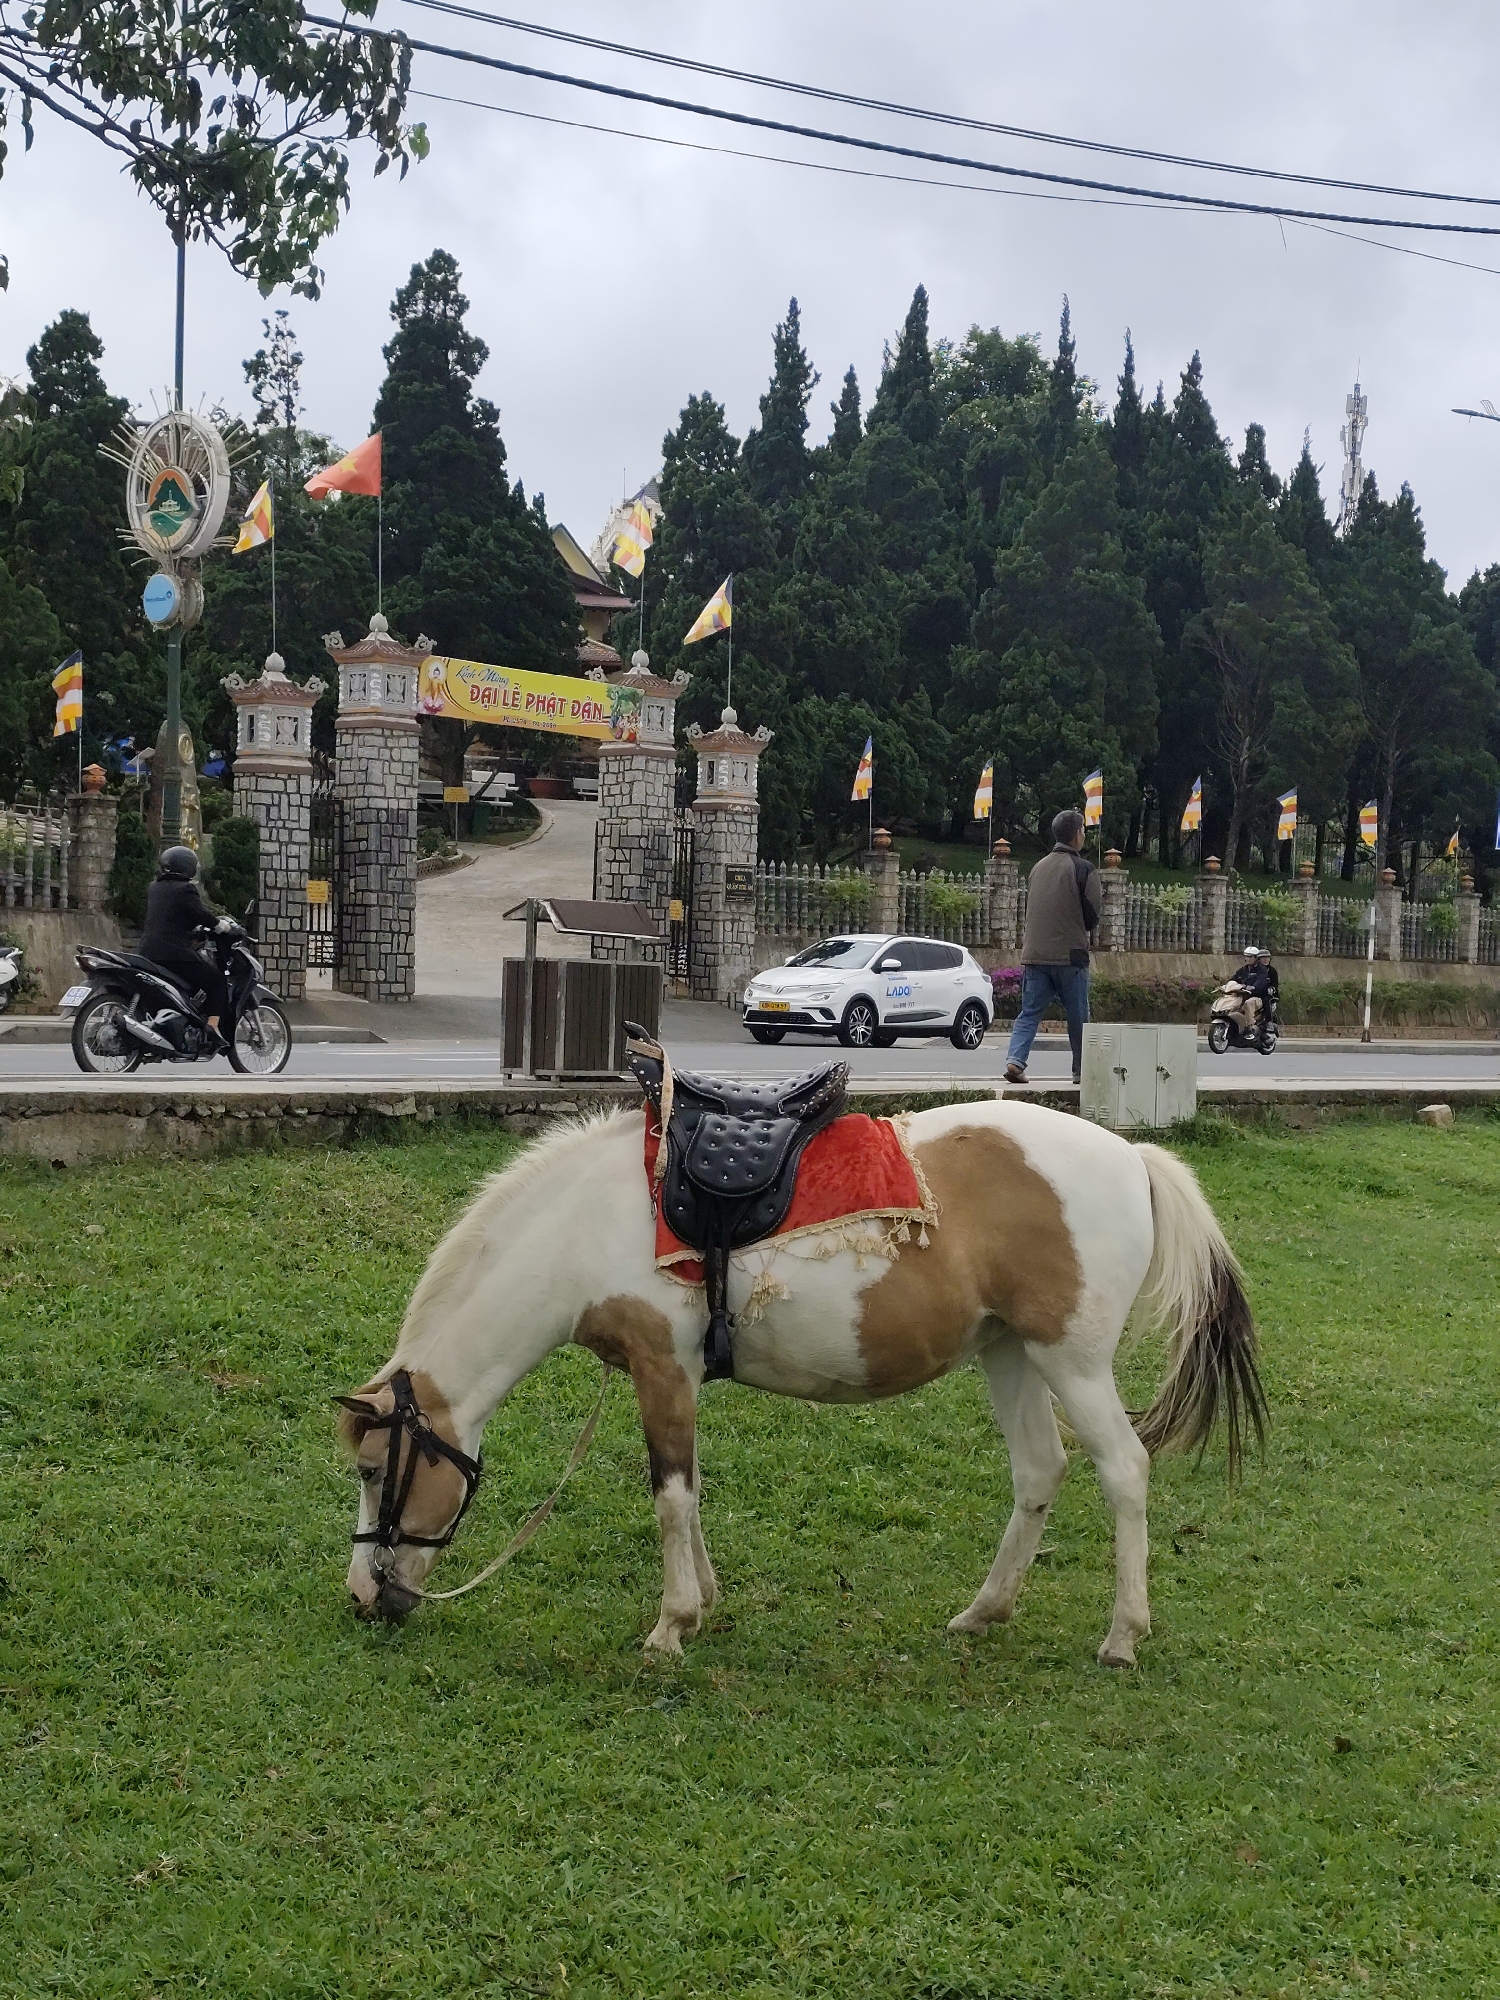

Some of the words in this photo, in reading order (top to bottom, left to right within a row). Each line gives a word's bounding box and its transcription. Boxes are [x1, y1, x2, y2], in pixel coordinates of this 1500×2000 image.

[469, 683, 498, 710] ĐẠI
[502, 682, 522, 709] LỄ
[525, 691, 568, 719] PHẬT
[571, 695, 604, 722] ĐẢN
[885, 985, 911, 997] LADO
